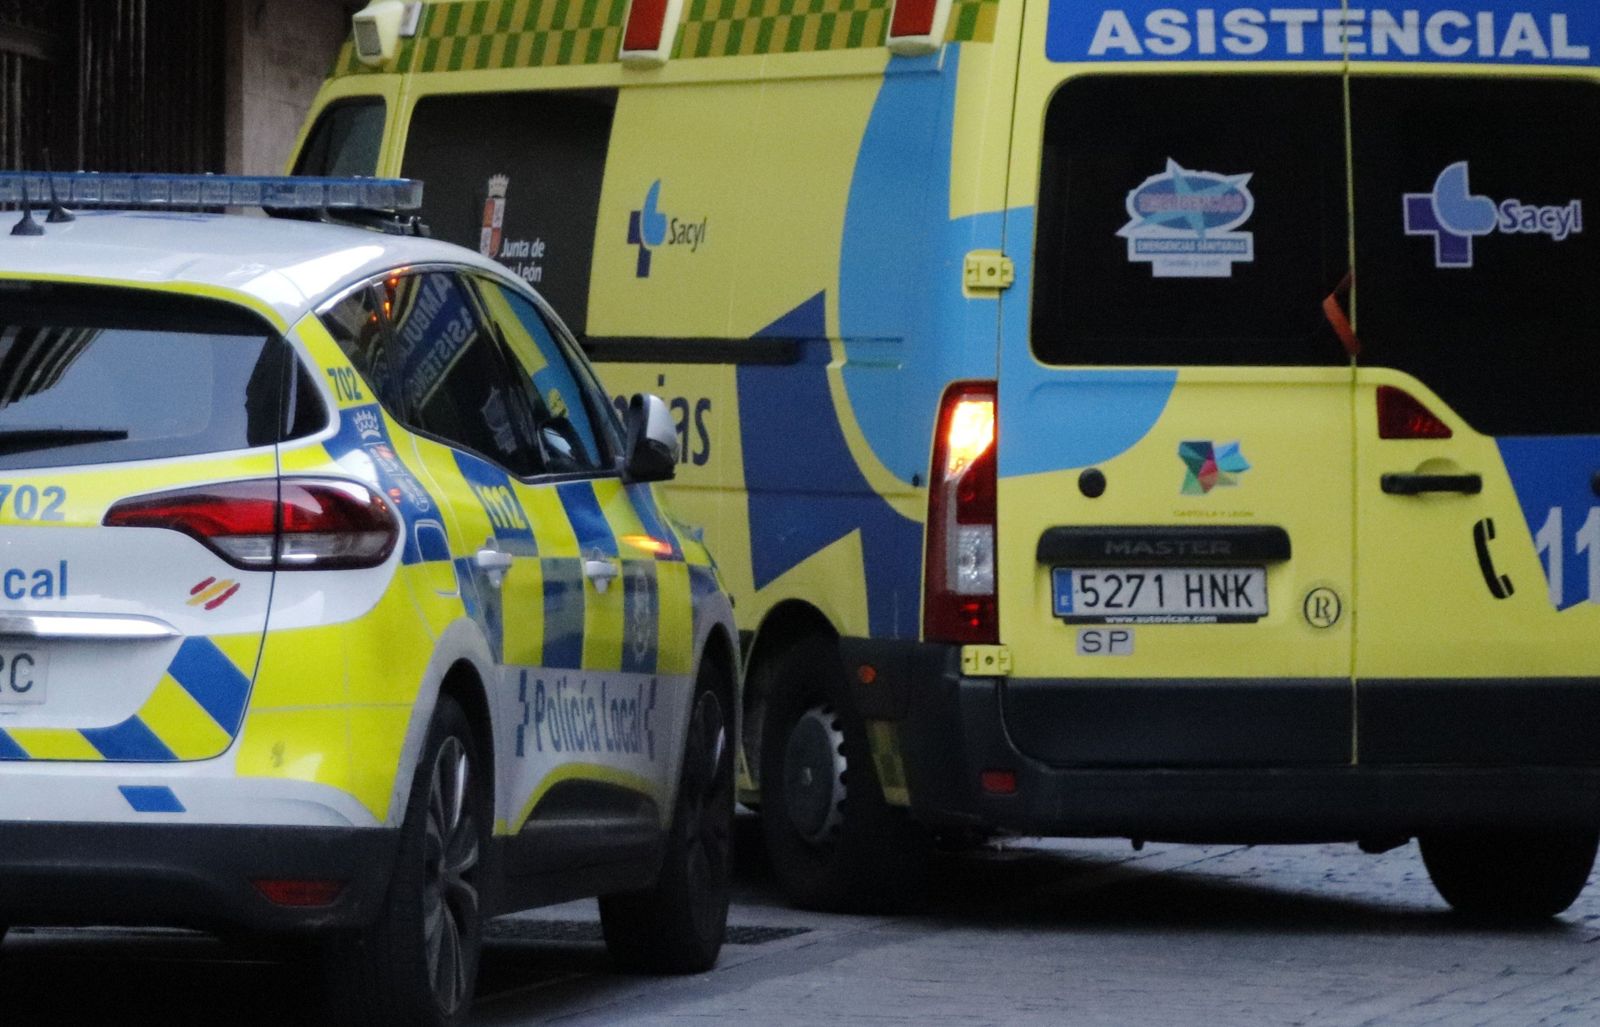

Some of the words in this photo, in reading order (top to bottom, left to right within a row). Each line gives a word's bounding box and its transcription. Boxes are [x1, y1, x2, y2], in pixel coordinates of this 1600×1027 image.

[1087, 8, 1591, 60] ASISTENCIAL
[669, 216, 708, 252] Sacyl
[1500, 199, 1582, 240] Sacyl
[500, 237, 529, 259] Junta
[531, 237, 546, 258] de
[327, 366, 363, 401] 702
[1103, 540, 1232, 555] MASTER
[1080, 574, 1164, 608] 5271
[1185, 573, 1254, 608] HNK
[1104, 614, 1218, 624] www.autovican.com
[535, 675, 600, 753] Policía
[602, 680, 643, 753] Local
